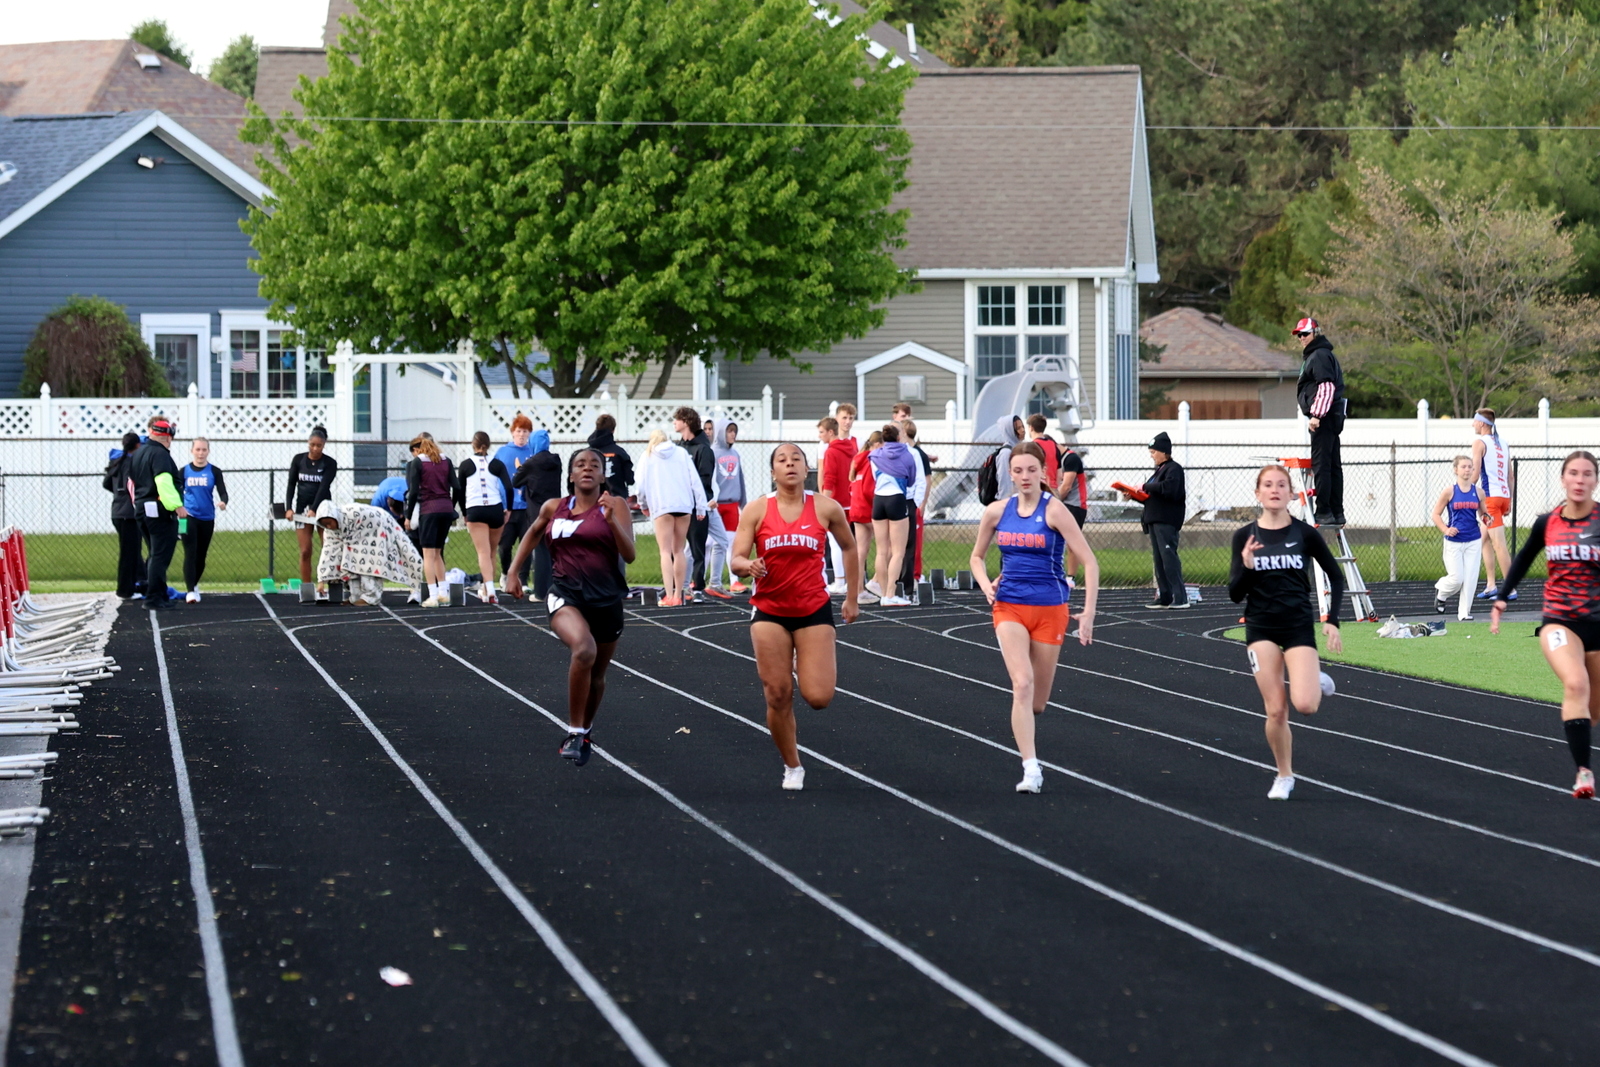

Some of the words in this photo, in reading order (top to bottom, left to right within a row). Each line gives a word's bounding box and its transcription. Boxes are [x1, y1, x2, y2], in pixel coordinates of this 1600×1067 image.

[727, 462, 736, 473] B
[187, 477, 208, 487] CLYDE
[298, 472, 323, 483] PERKIN
[551, 517, 585, 540] W
[764, 533, 819, 551] BELLEVUE
[997, 531, 1046, 548] EDISON
[1253, 554, 1303, 571] ERKINS
[1551, 631, 1562, 648] 3
